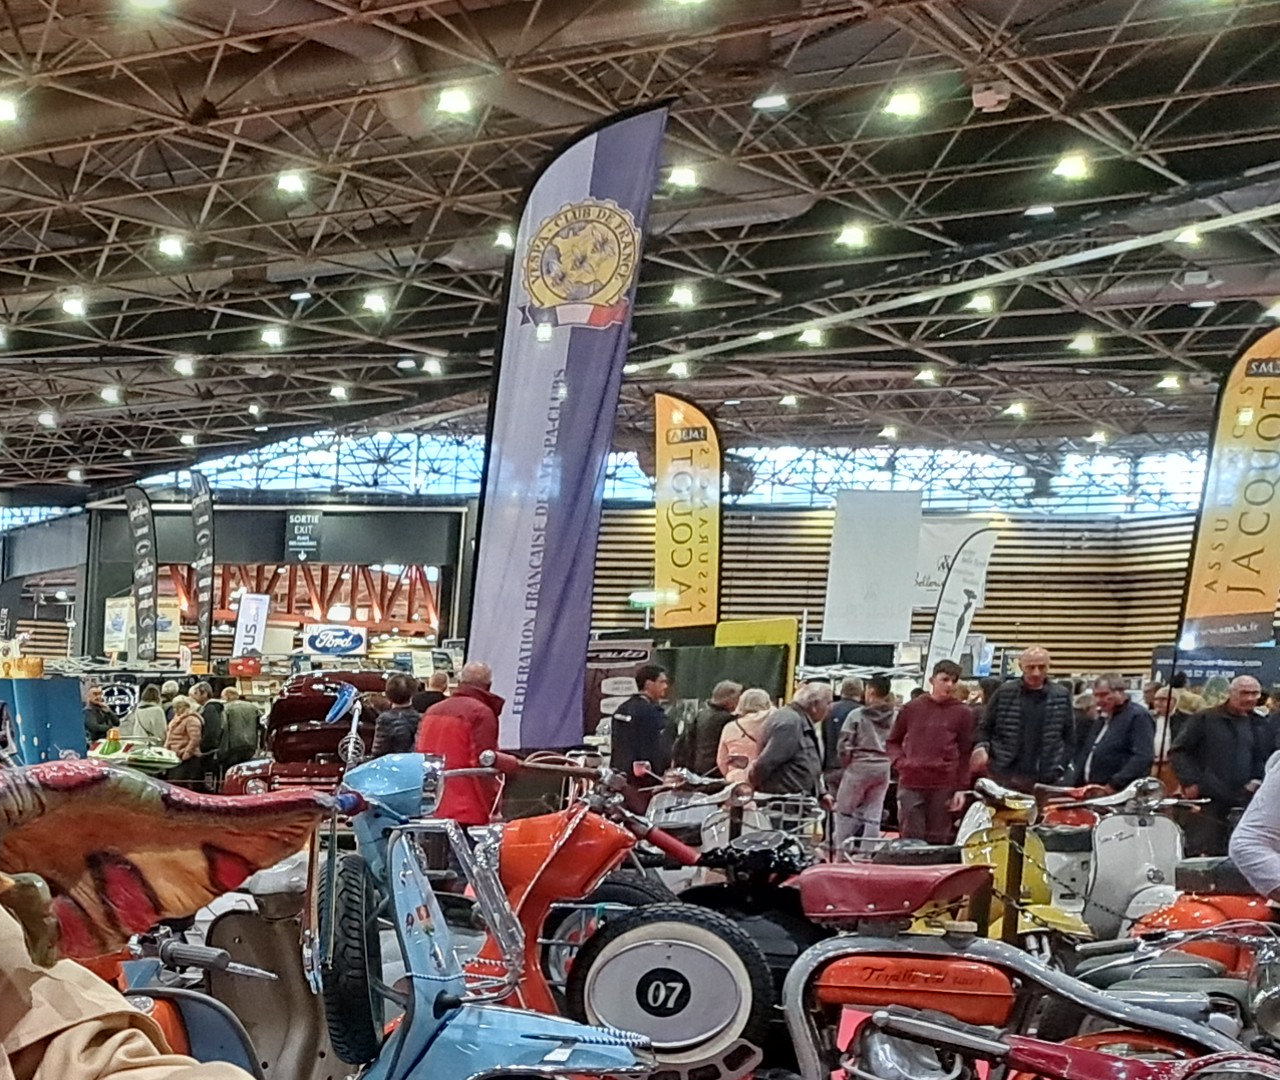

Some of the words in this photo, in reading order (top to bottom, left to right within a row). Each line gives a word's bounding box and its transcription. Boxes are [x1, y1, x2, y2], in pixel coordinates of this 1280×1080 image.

[530, 236, 550, 285] VESPA
[554, 207, 592, 229] CLUB
[596, 209, 616, 222] DE
[613, 222, 634, 281] FRANCE
[1226, 386, 1280, 596] JACQUOT
[289, 514, 320, 524] SORTIE
[294, 525, 313, 535] EXIT
[512, 616, 536, 715] FEDERATION
[647, 980, 684, 1009] 07
